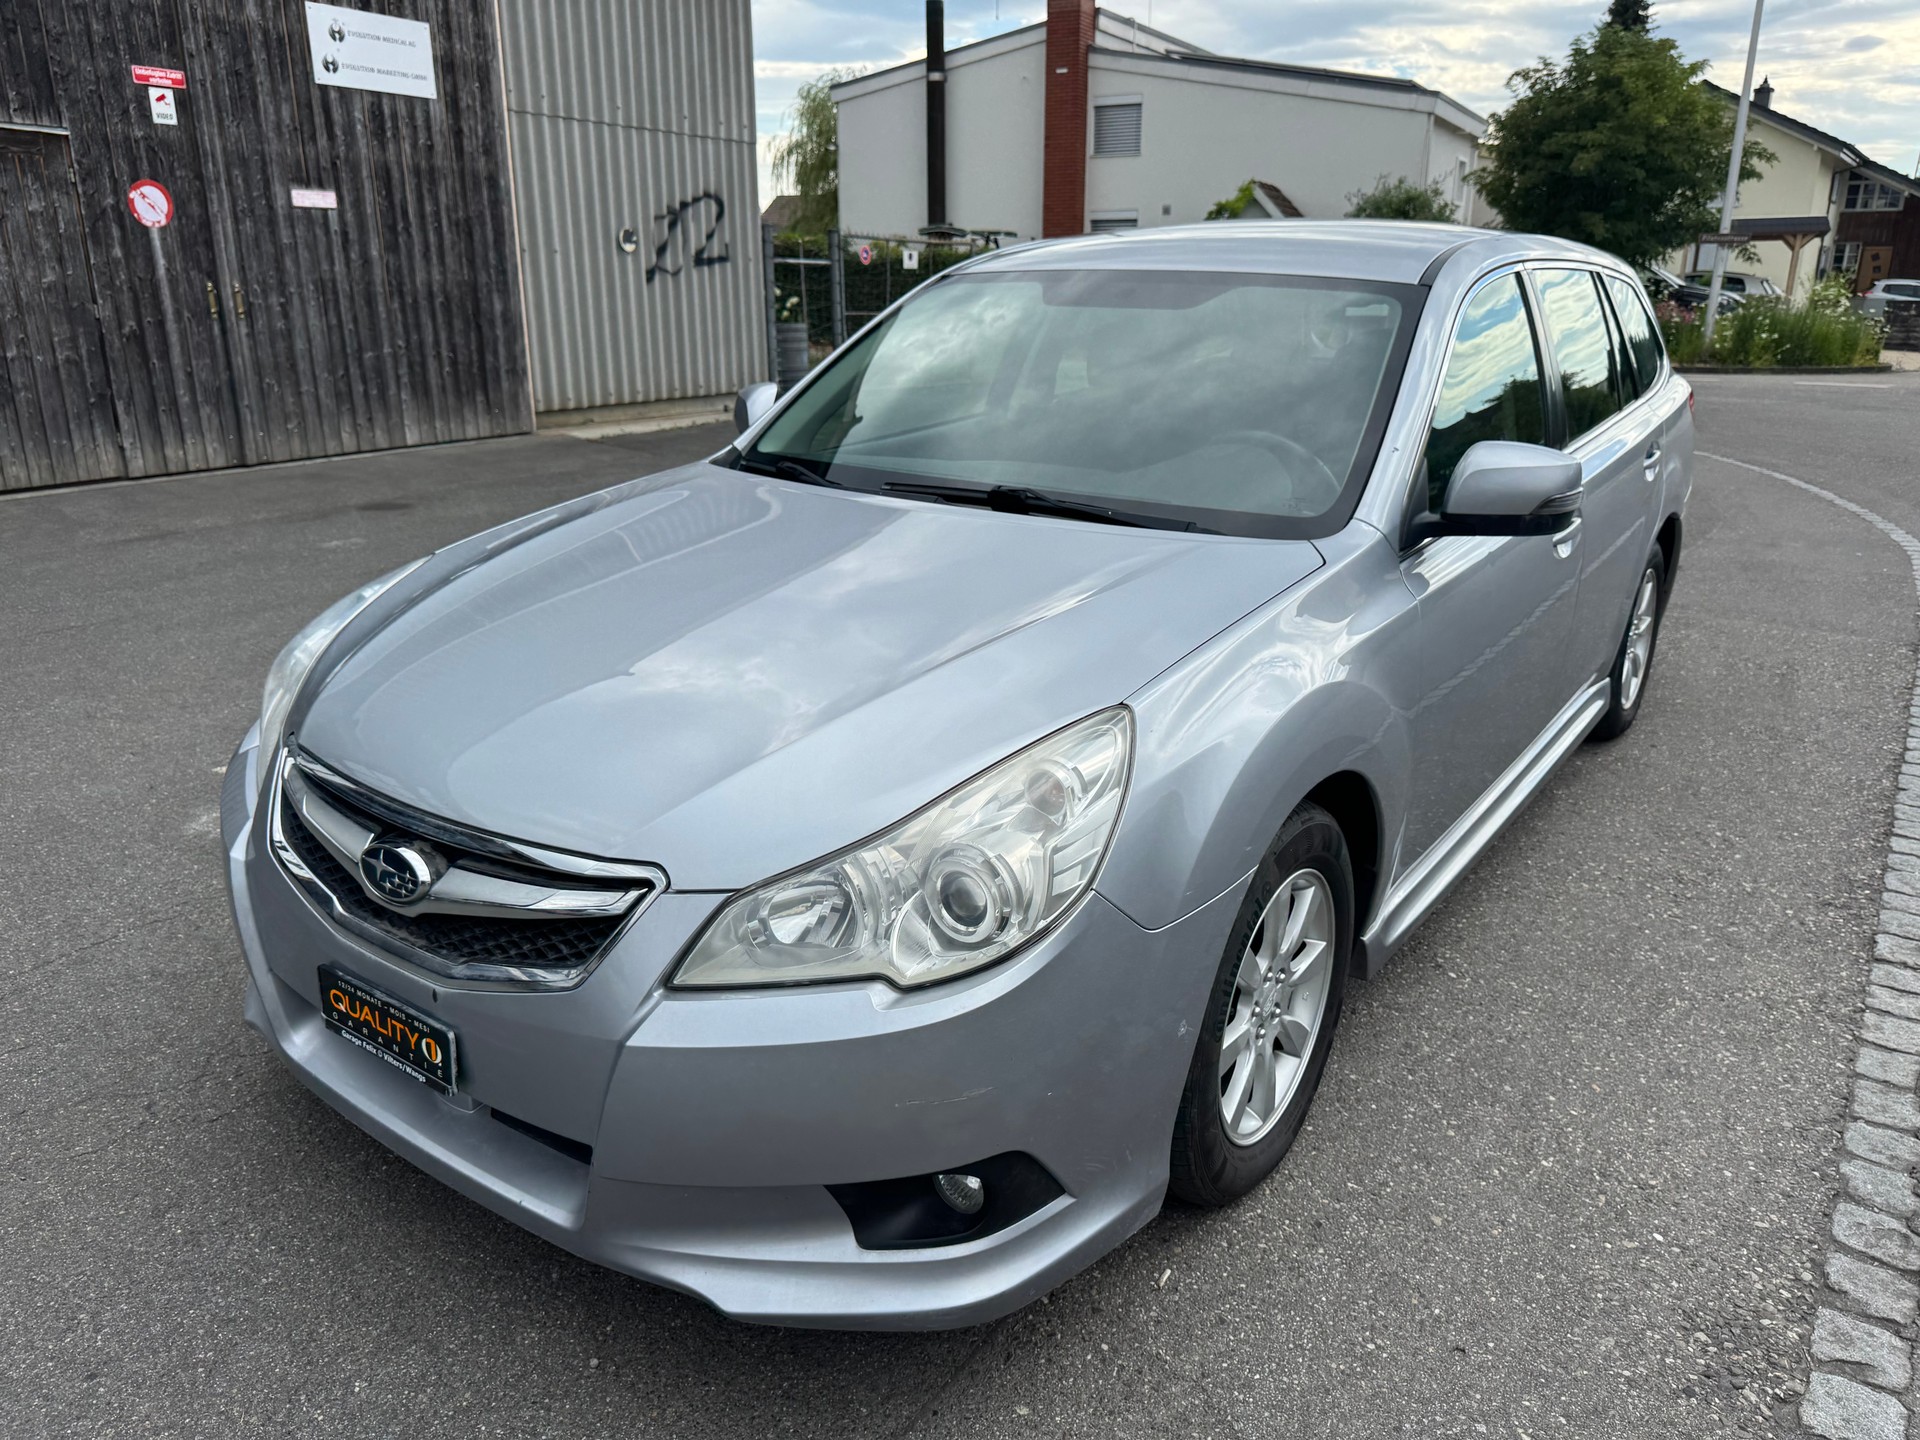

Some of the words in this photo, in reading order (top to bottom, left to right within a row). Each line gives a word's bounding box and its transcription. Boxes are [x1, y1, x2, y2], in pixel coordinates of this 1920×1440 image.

[347, 30, 381, 42] EVOLUTION
[382, 36, 407, 47] MEDICAL
[341, 62, 375, 73] EVOLUTION
[376, 67, 409, 79] MARKETING
[155, 112, 174, 120] VIDEO
[338, 980, 355, 993] 12/24
[356, 989, 382, 1008] MONATE
[389, 1006, 406, 1020] MOIS
[413, 1020, 430, 1034] MESI
[330, 989, 419, 1050] QUALITY
[341, 1030, 362, 1047] Garage
[363, 1041, 377, 1055] Felix
